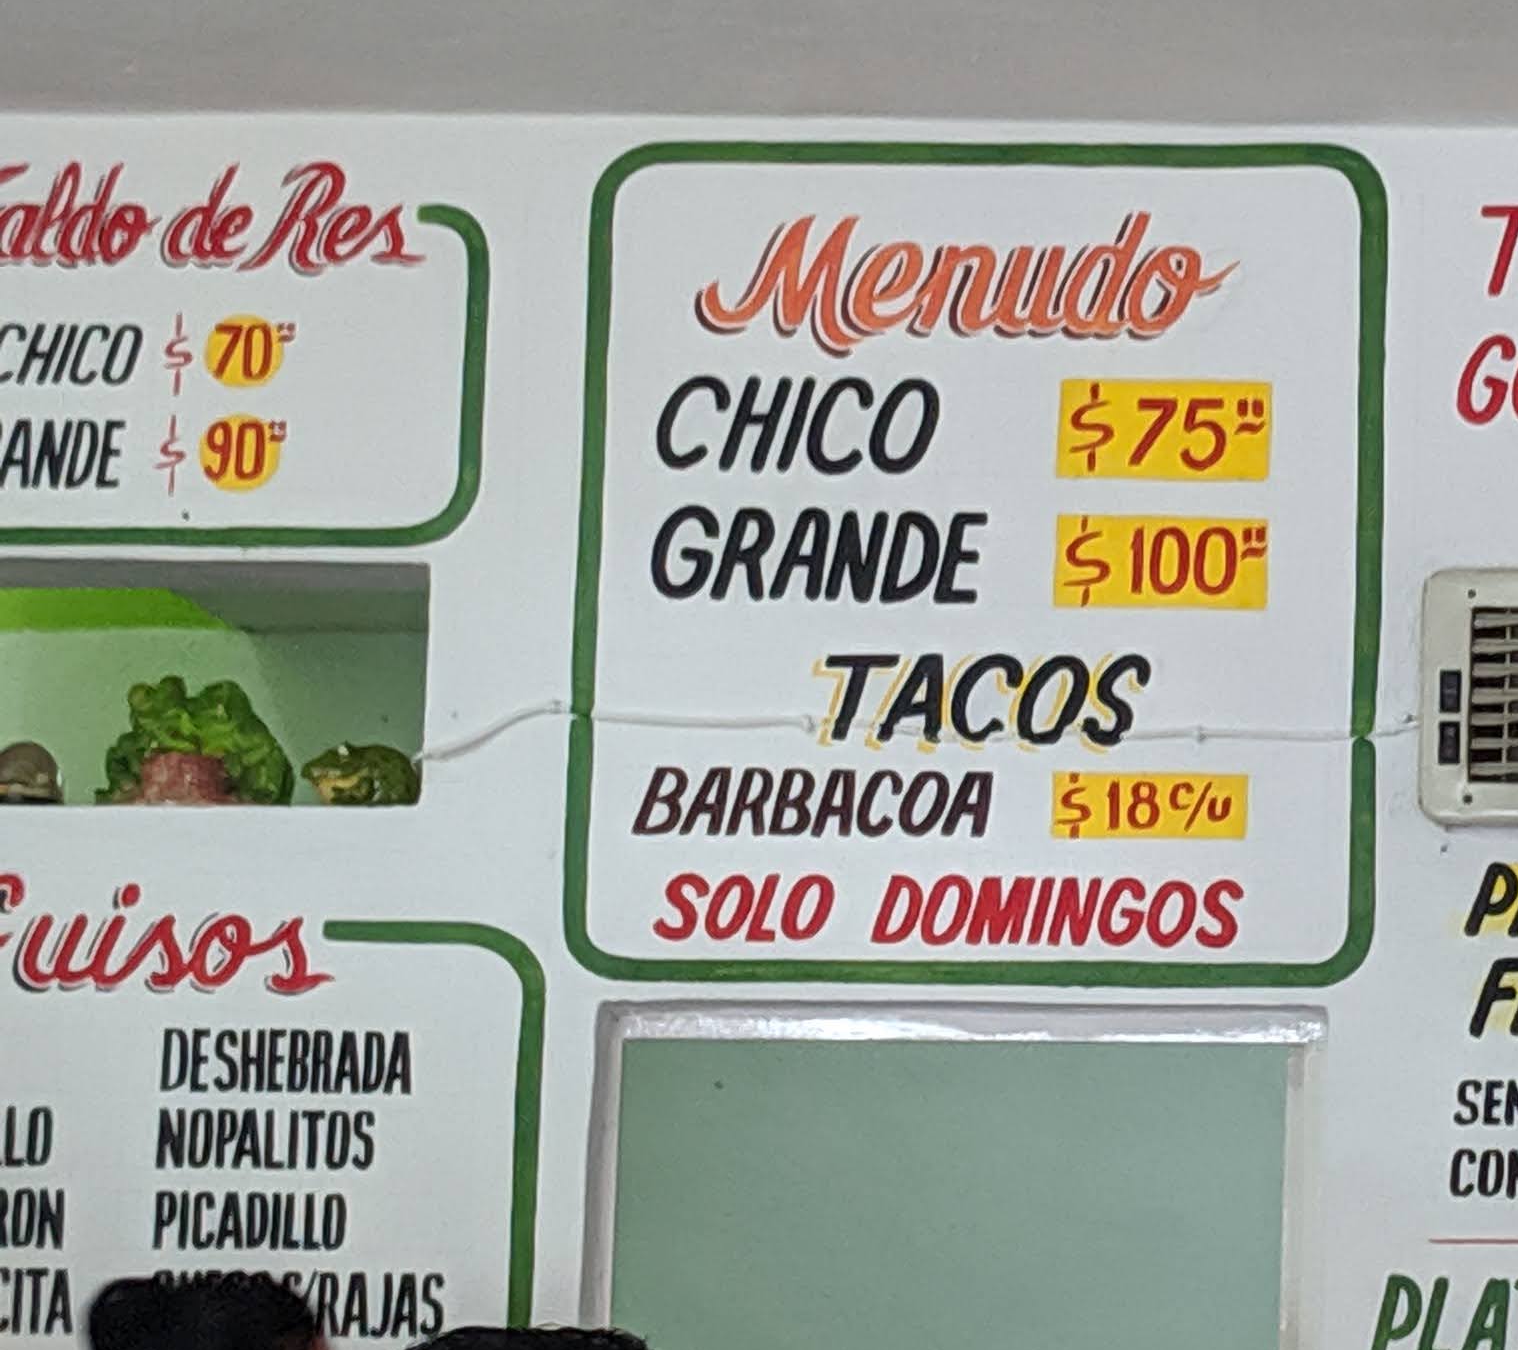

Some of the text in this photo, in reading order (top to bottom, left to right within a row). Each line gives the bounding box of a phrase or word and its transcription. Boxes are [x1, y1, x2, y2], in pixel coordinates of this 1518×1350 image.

[160, 162, 253, 268] de
[237, 161, 427, 276] Res
[694, 212, 1240, 357] Menudo
[0, 419, 125, 490] ANDE
[655, 376, 940, 475] CHICO
[651, 504, 988, 605] GRANDE
[815, 652, 1151, 749] TACOS
[632, 768, 993, 838] BARBACOA
[652, 873, 1244, 948] SOLO DOMINGOS
[160, 1028, 412, 1094] DESHEBRADA
[155, 1109, 375, 1169] NOPALITOS
[153, 1191, 348, 1250] PICADILLO
